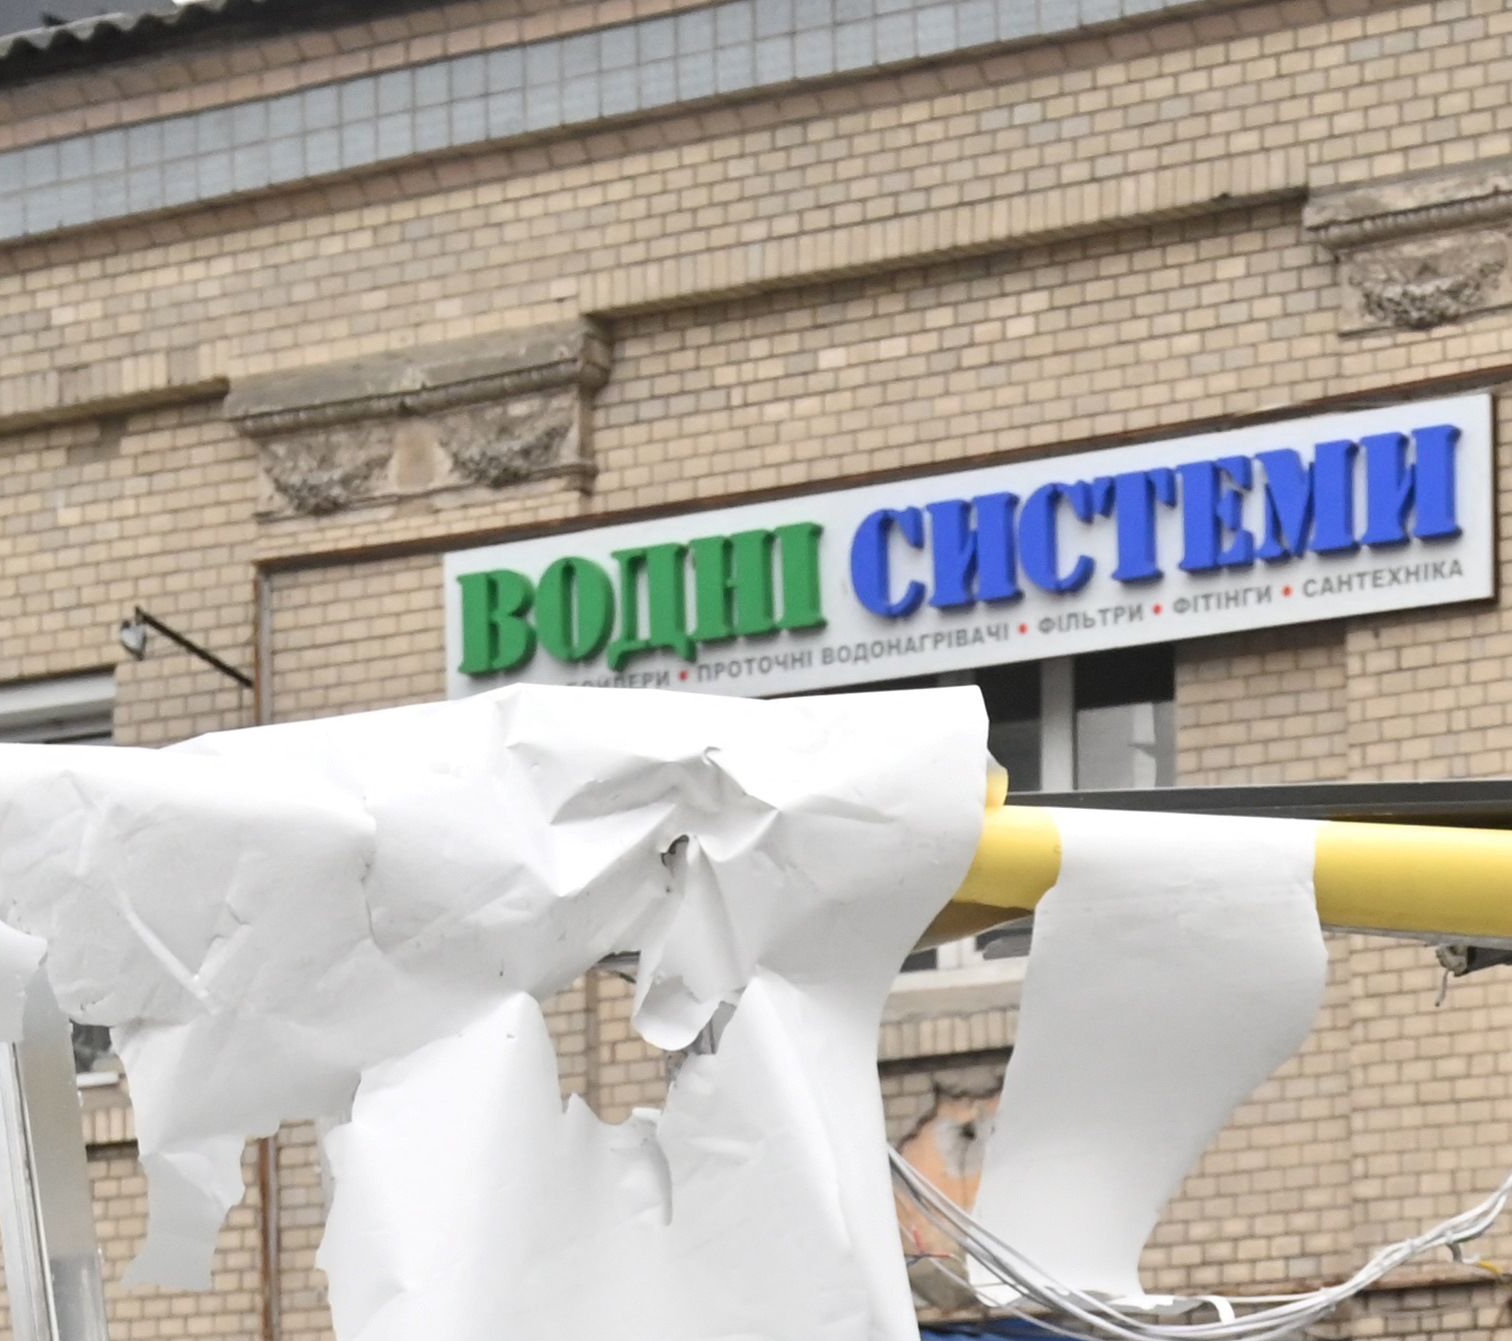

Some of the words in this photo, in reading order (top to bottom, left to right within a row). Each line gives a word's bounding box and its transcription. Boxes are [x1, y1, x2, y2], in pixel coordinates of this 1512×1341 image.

[458, 521, 828, 676] ВОДНІ
[851, 423, 1463, 621] СИСТЕМИ
[697, 653, 813, 683] ПРОТОЧНІ
[822, 624, 1009, 665] ВОДОНАГРІВАЧІ
[1038, 603, 1144, 636] ФІЛЬТРИ
[1172, 585, 1272, 615] ФІТІНГИ
[1302, 558, 1464, 598] САНТЕХНІКА
